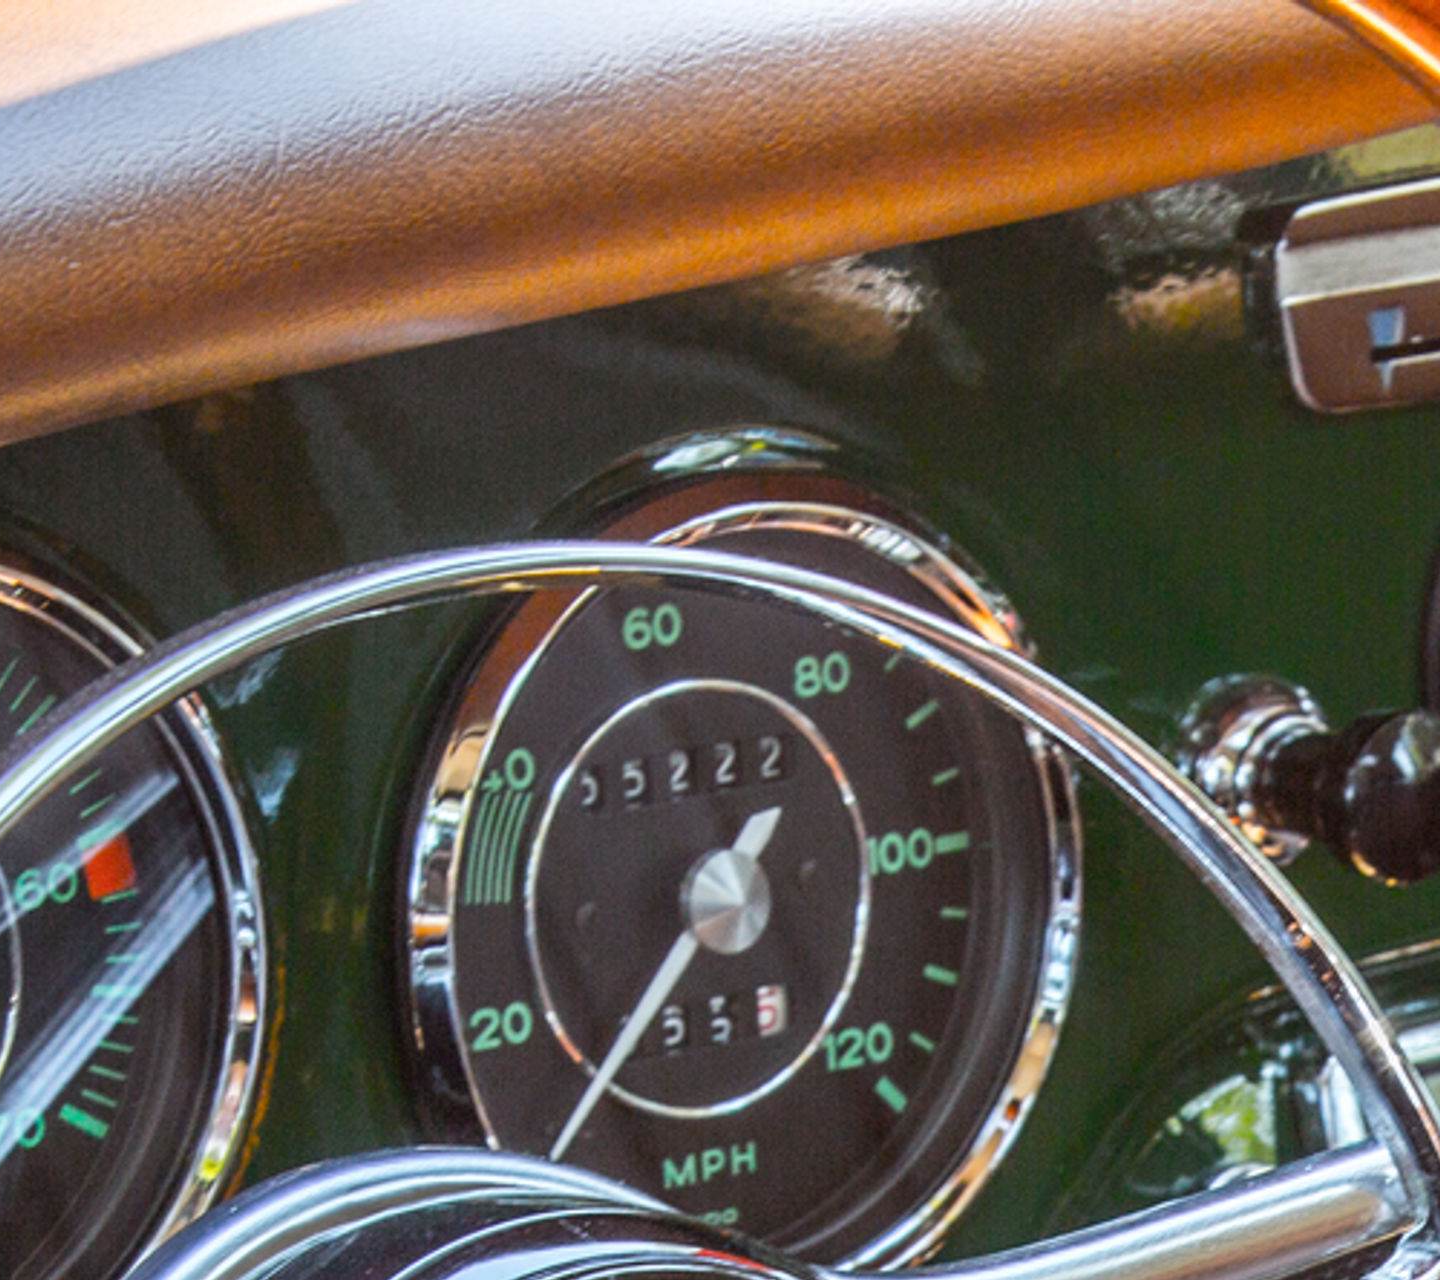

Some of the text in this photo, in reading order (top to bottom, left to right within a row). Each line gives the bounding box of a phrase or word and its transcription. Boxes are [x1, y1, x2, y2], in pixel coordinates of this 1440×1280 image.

[622, 602, 683, 650] 60
[793, 651, 851, 698] 80
[864, 827, 935, 877] 100
[14, 862, 79, 912] 60
[469, 1000, 533, 1053] 20
[820, 1021, 894, 1073] 120
[663, 1140, 758, 1190] MPH
